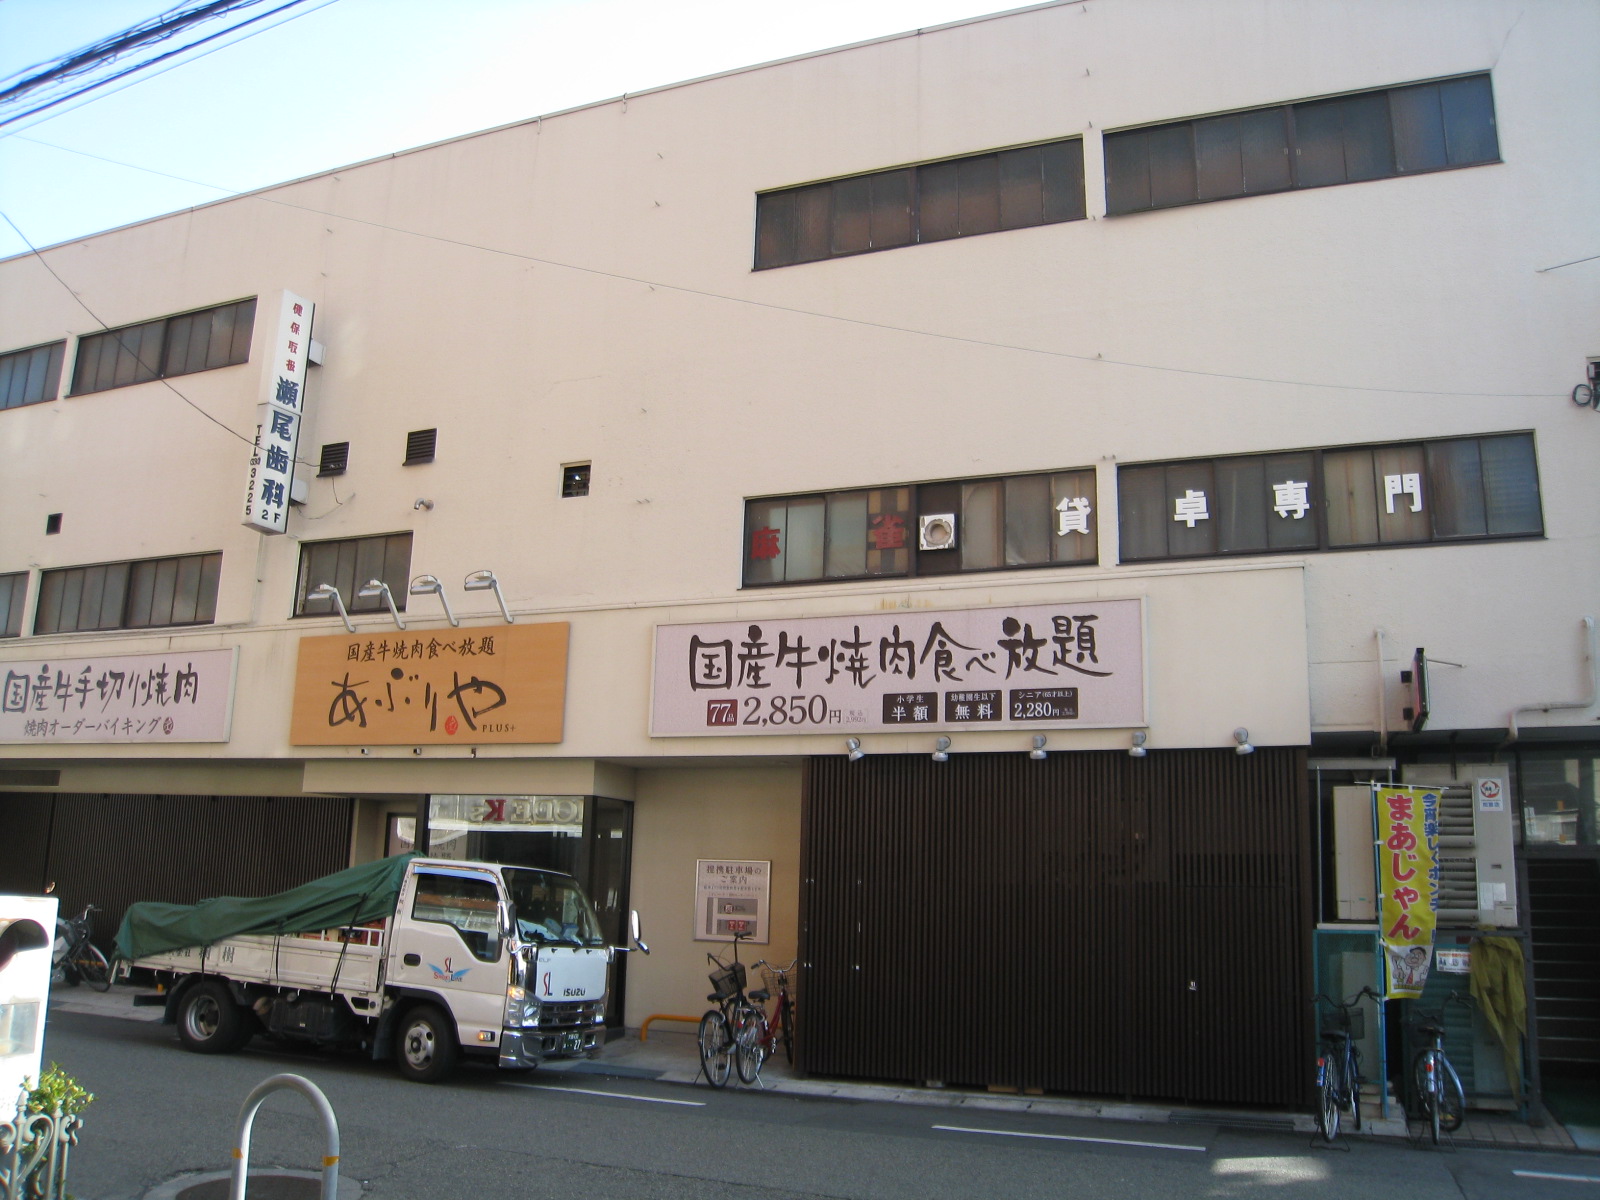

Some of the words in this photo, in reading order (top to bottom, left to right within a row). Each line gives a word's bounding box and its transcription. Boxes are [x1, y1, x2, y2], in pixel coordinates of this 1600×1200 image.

[261, 376, 299, 509] 瀬尾歯科
[262, 509, 281, 523] 2F
[347, 636, 496, 662] 国産牛焼肉食べ放題
[689, 614, 1113, 692] 国産牛焼肉食べ放題
[3, 662, 199, 713] 国産牛手切り焼肉
[896, 694, 924, 704] 小学生
[328, 667, 507, 732] あぶりや
[743, 694, 842, 727] 2,850円
[1014, 702, 1060, 719] 2,280円
[891, 705, 929, 722] 半額
[955, 703, 994, 720] 無料
[24, 717, 162, 737] 焼肉オーダーバイキング
[1386, 794, 1421, 940] まあじゃん
[563, 988, 586, 997] ISUZU
